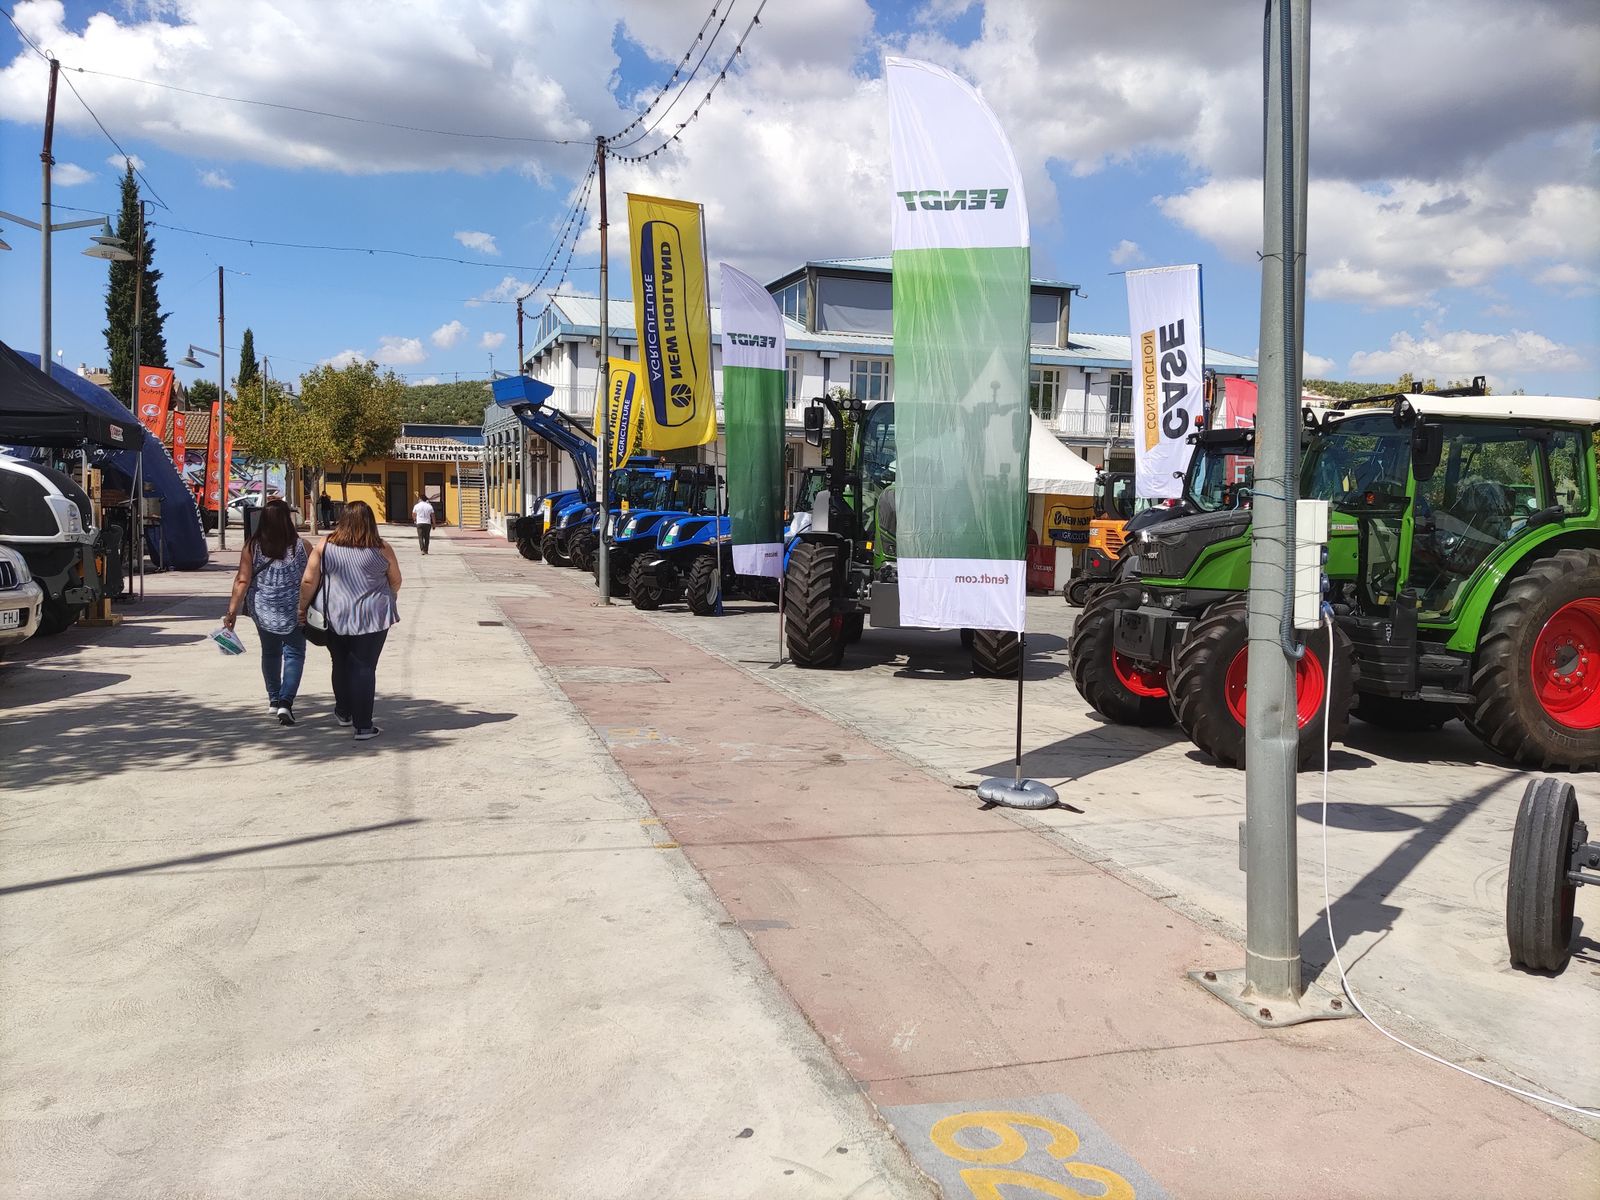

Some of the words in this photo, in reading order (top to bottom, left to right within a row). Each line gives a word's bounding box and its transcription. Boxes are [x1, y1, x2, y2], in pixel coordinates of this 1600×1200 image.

[609, 380, 623, 428] HOLLAND
[618, 399, 631, 457] AGRICULTURE
[404, 444, 479, 452] FERTILIZANTES
[396, 452, 469, 460] HERRAMIENTAS
[5, 611, 18, 624] FHJ
